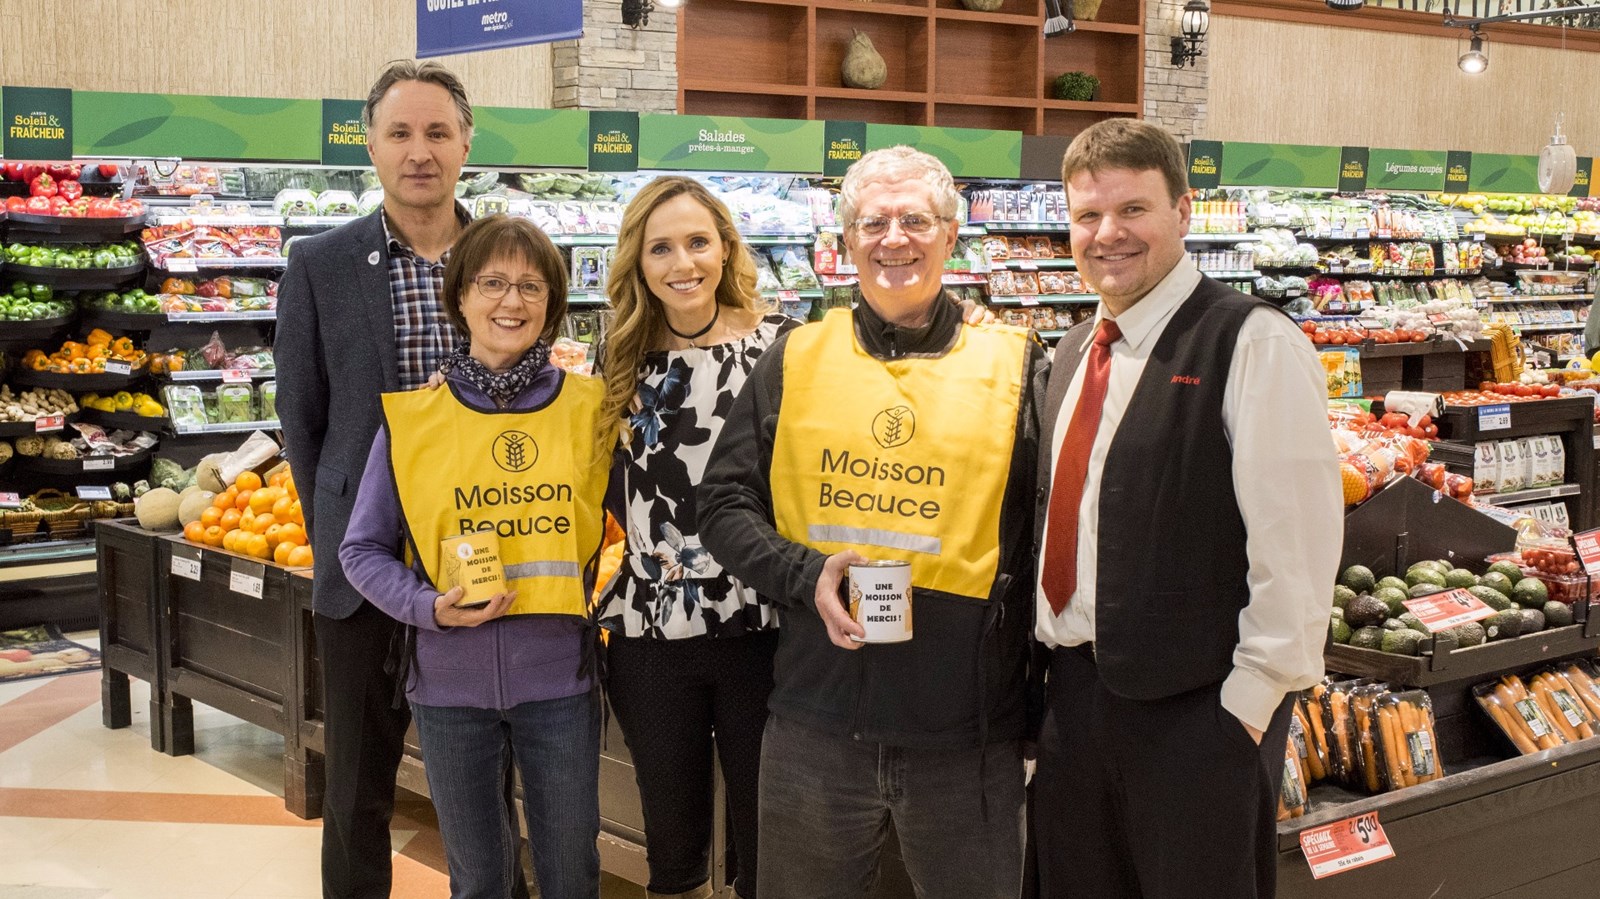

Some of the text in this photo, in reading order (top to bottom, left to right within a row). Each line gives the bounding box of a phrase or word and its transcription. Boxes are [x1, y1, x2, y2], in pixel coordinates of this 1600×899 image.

[481, 12, 508, 25] metro
[15, 114, 61, 127] Soleil &
[10, 126, 65, 139] FRAÎCHEUR
[332, 122, 360, 133] Soleil
[328, 133, 369, 145] FRAÎCHEU
[597, 132, 630, 143] Soleil &
[698, 129, 745, 143] Salades
[593, 142, 633, 154] FRAÎCHEUR
[688, 143, 755, 154] prêtes-à-manger
[831, 141, 852, 150] Soleil
[1385, 162, 1418, 175] Légumes
[1418, 164, 1444, 176] coupés
[821, 448, 945, 486] Moisson
[454, 482, 572, 510] Moisson
[819, 482, 941, 519] Beauce
[459, 515, 571, 538] Beauce
[474, 547, 490, 555] UNE
[467, 555, 498, 566] MOISSON
[865, 593, 902, 601] MOISSON
[1303, 829, 1332, 847] SPÉCIAUX
